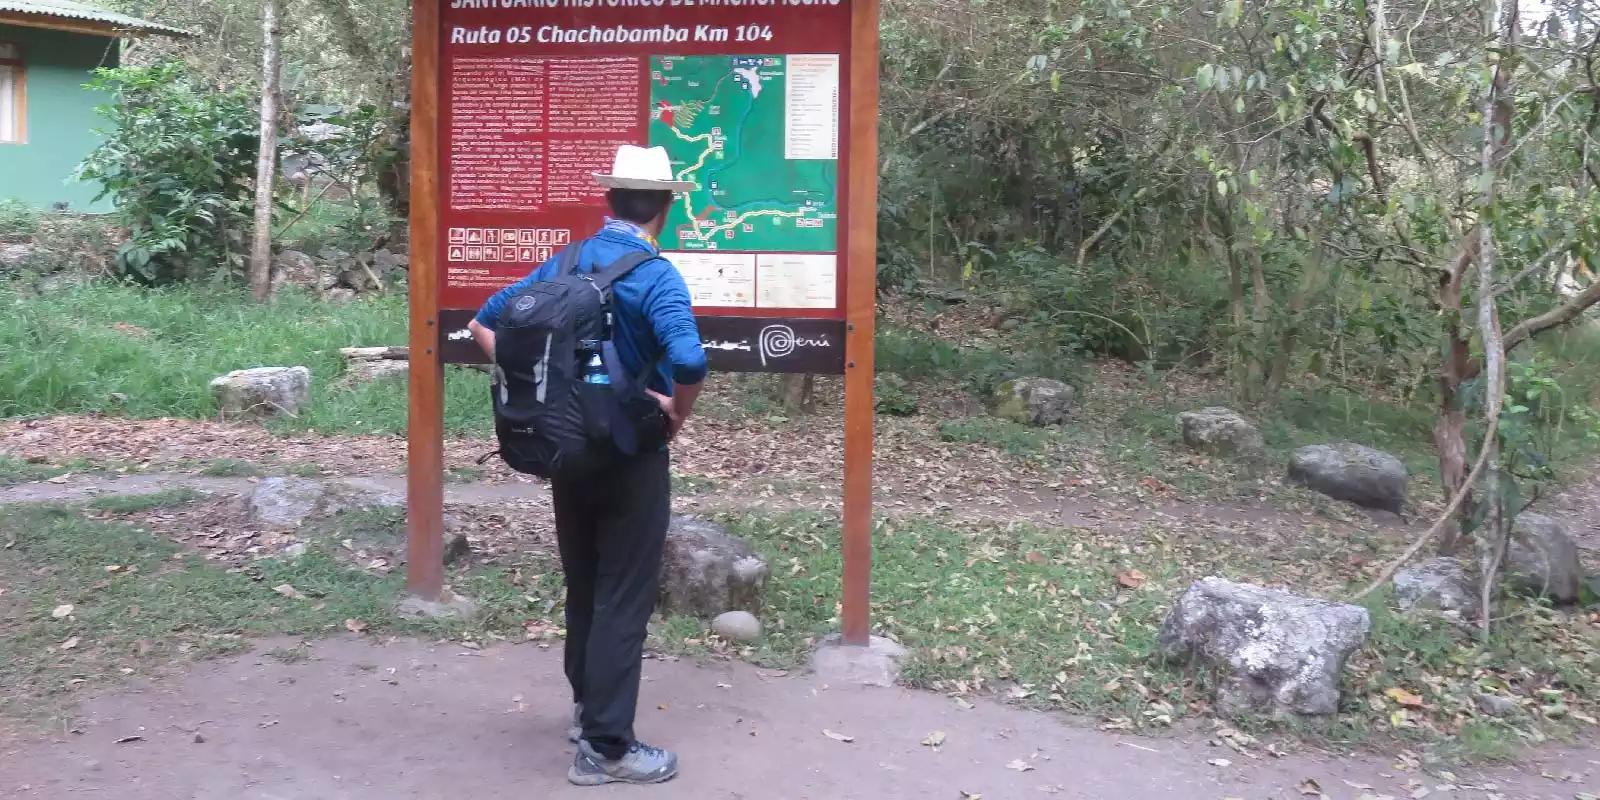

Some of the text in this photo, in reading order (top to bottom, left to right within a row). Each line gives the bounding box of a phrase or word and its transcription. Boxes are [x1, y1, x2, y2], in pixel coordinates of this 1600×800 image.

[450, 24, 773, 44] Ruta 05 Chachabamba Km 104
[759, 324, 832, 367] Perú
